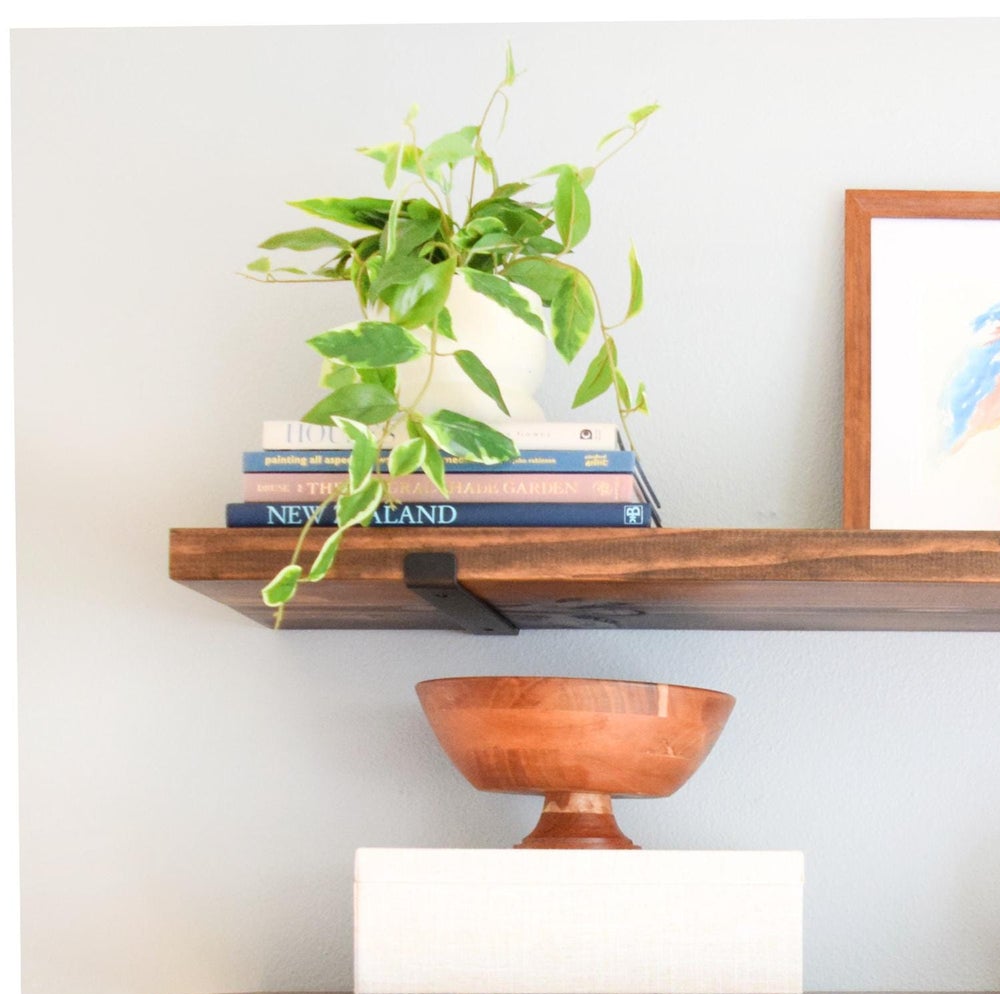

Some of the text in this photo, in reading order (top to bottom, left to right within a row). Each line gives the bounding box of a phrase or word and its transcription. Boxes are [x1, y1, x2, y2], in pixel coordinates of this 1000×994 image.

[265, 455, 307, 466] painting
[309, 455, 322, 464] all
[502, 480, 579, 495] GARDEN
[267, 505, 325, 525] NEW
